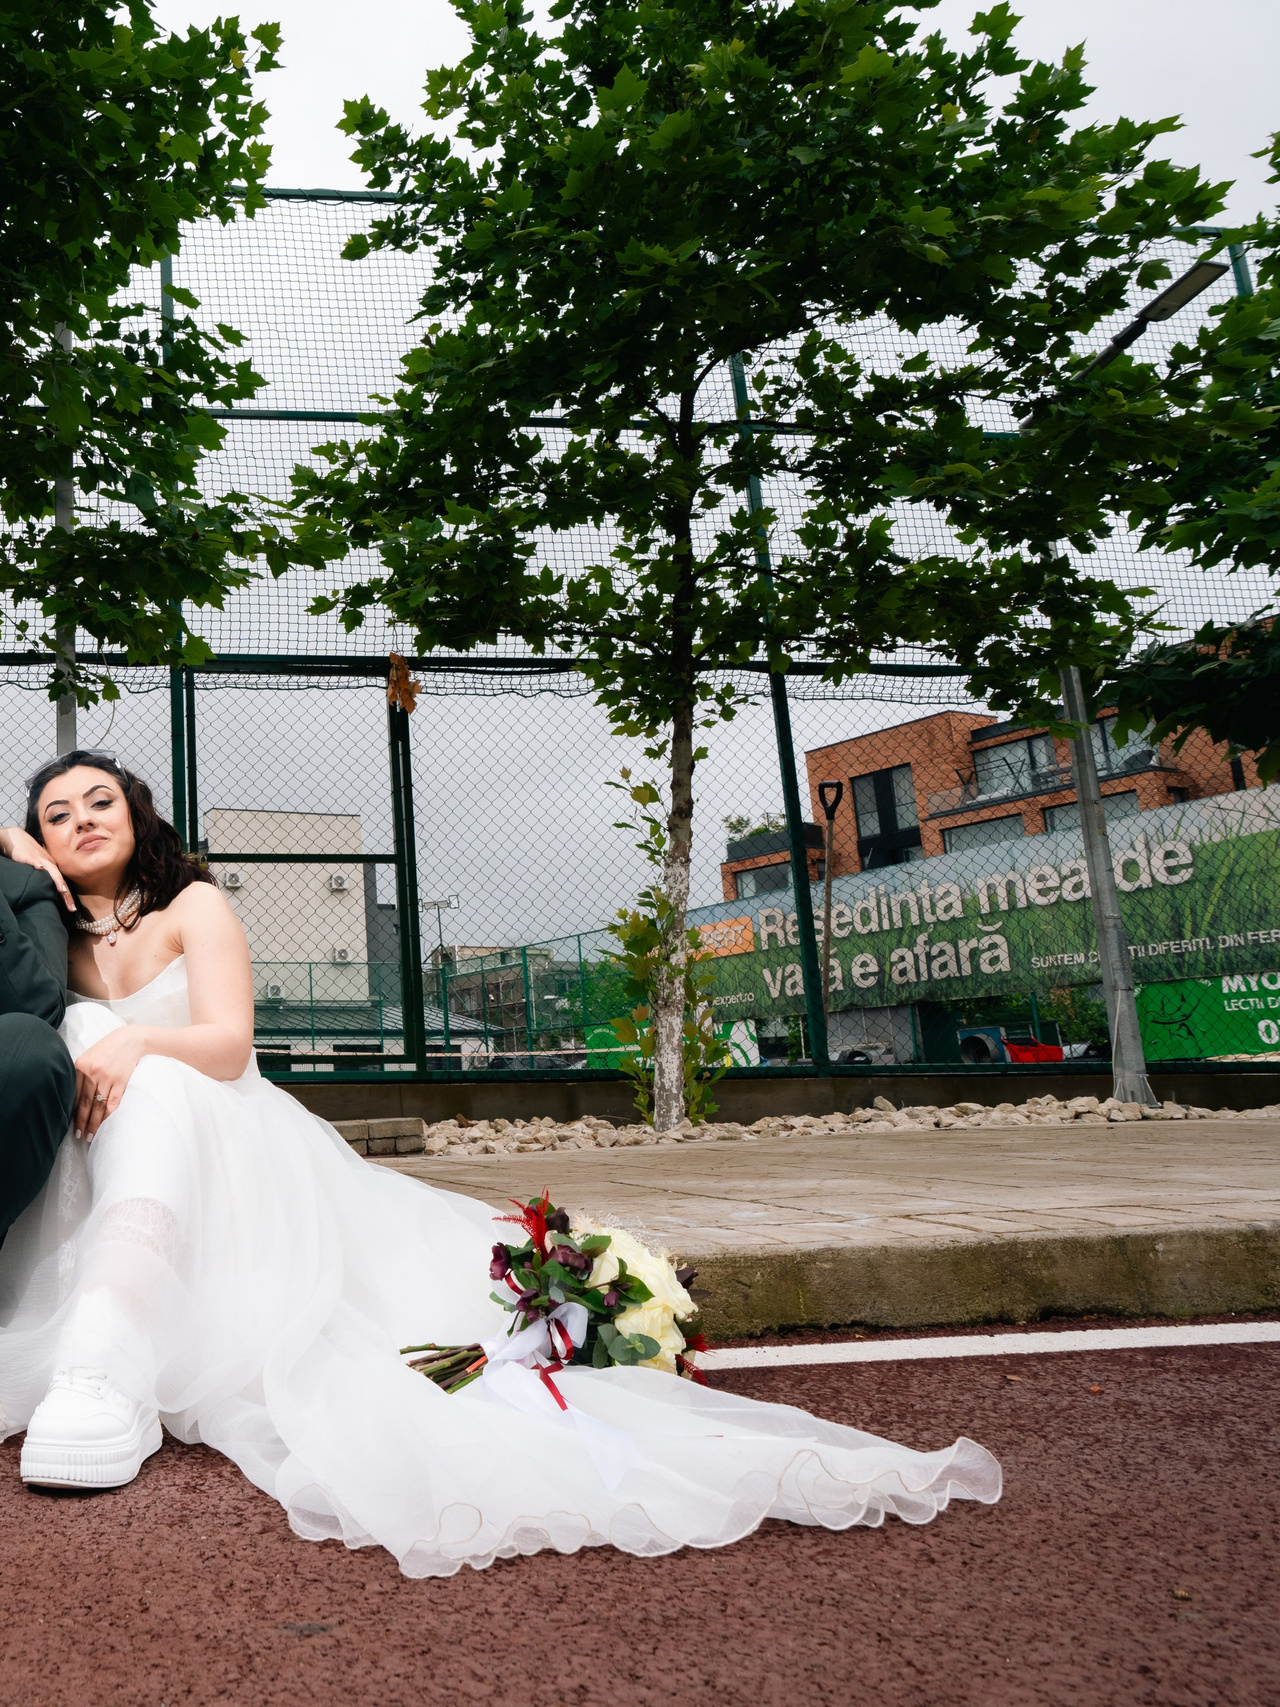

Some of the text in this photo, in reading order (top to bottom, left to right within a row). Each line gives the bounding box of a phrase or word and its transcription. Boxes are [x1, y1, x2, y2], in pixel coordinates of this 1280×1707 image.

[976, 858, 1092, 914] mea
[1114, 831, 1194, 892] de
[762, 921, 1011, 998] vaă e afară
[1031, 953, 1085, 968] SUNTEM
[1218, 933, 1245, 948] DIN
